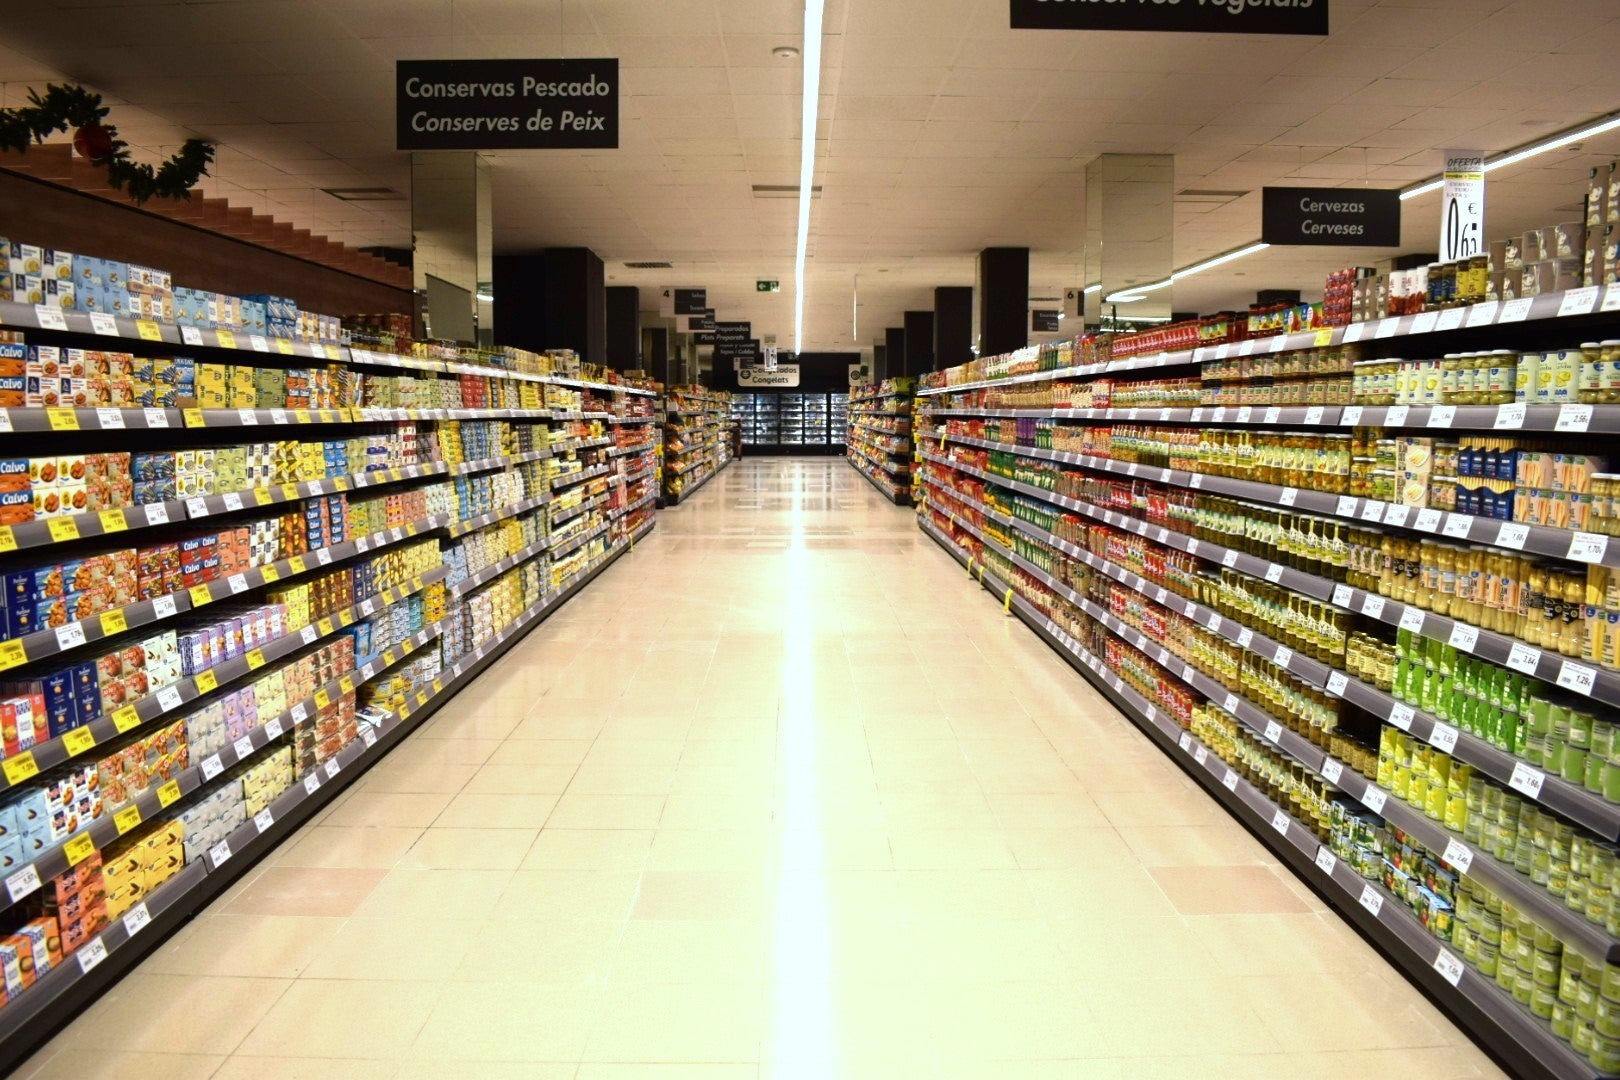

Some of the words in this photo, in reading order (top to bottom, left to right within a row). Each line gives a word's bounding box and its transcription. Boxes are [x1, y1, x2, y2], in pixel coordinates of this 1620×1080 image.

[405, 77, 515, 98] Conservas
[523, 74, 610, 97] Pescado
[411, 110, 519, 132] Conserves
[526, 109, 553, 131] de
[560, 110, 606, 131] Peix
[1447, 157, 1481, 167] OFERTA
[1300, 198, 1365, 213] Cervezas
[1301, 219, 1364, 235] Cerveses
[1067, 291, 1074, 299] 6
[752, 376, 788, 385] Congelats
[0, 462, 26, 473] Calvo
[2, 493, 28, 505] Calvo
[183, 540, 199, 551] Calvo
[202, 537, 216, 546] Calvo
[184, 563, 199, 574] Calvo
[204, 557, 218, 568] Calvo
